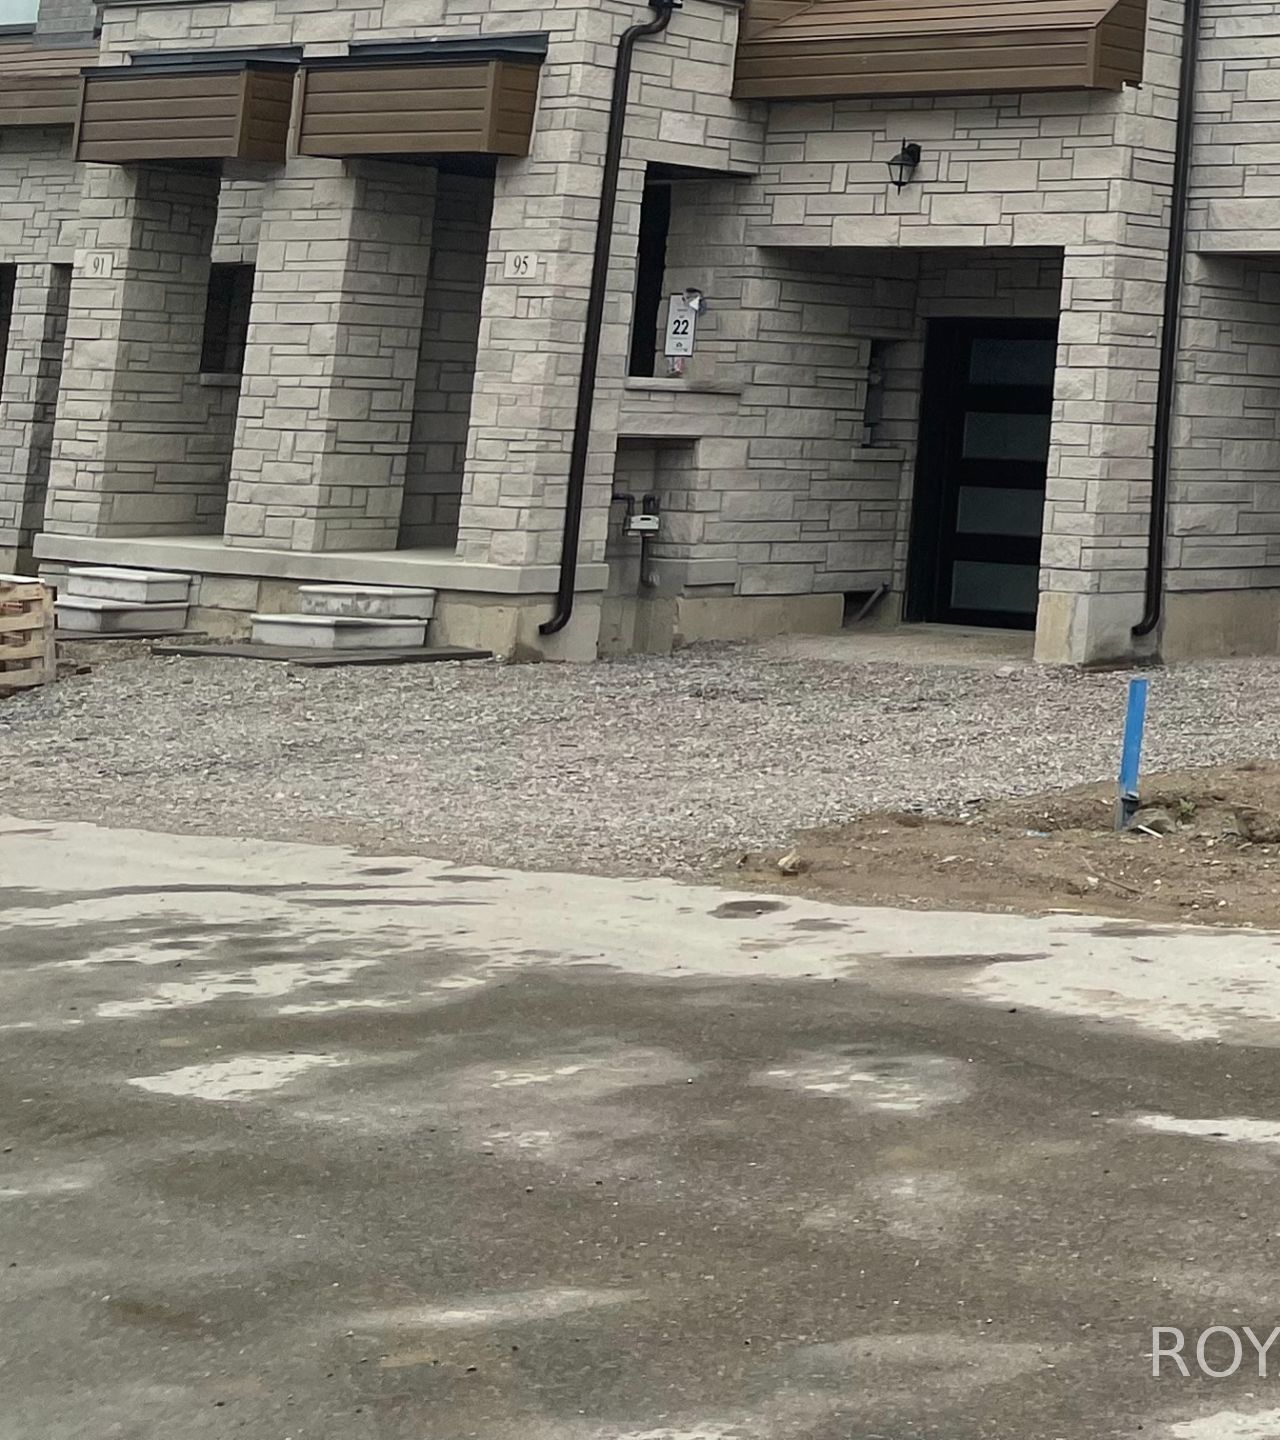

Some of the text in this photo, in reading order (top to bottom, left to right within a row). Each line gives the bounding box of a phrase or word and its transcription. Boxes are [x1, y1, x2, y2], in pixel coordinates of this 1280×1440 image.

[93, 255, 105, 276] 91
[513, 254, 529, 276] 95
[672, 319, 690, 336] 22
